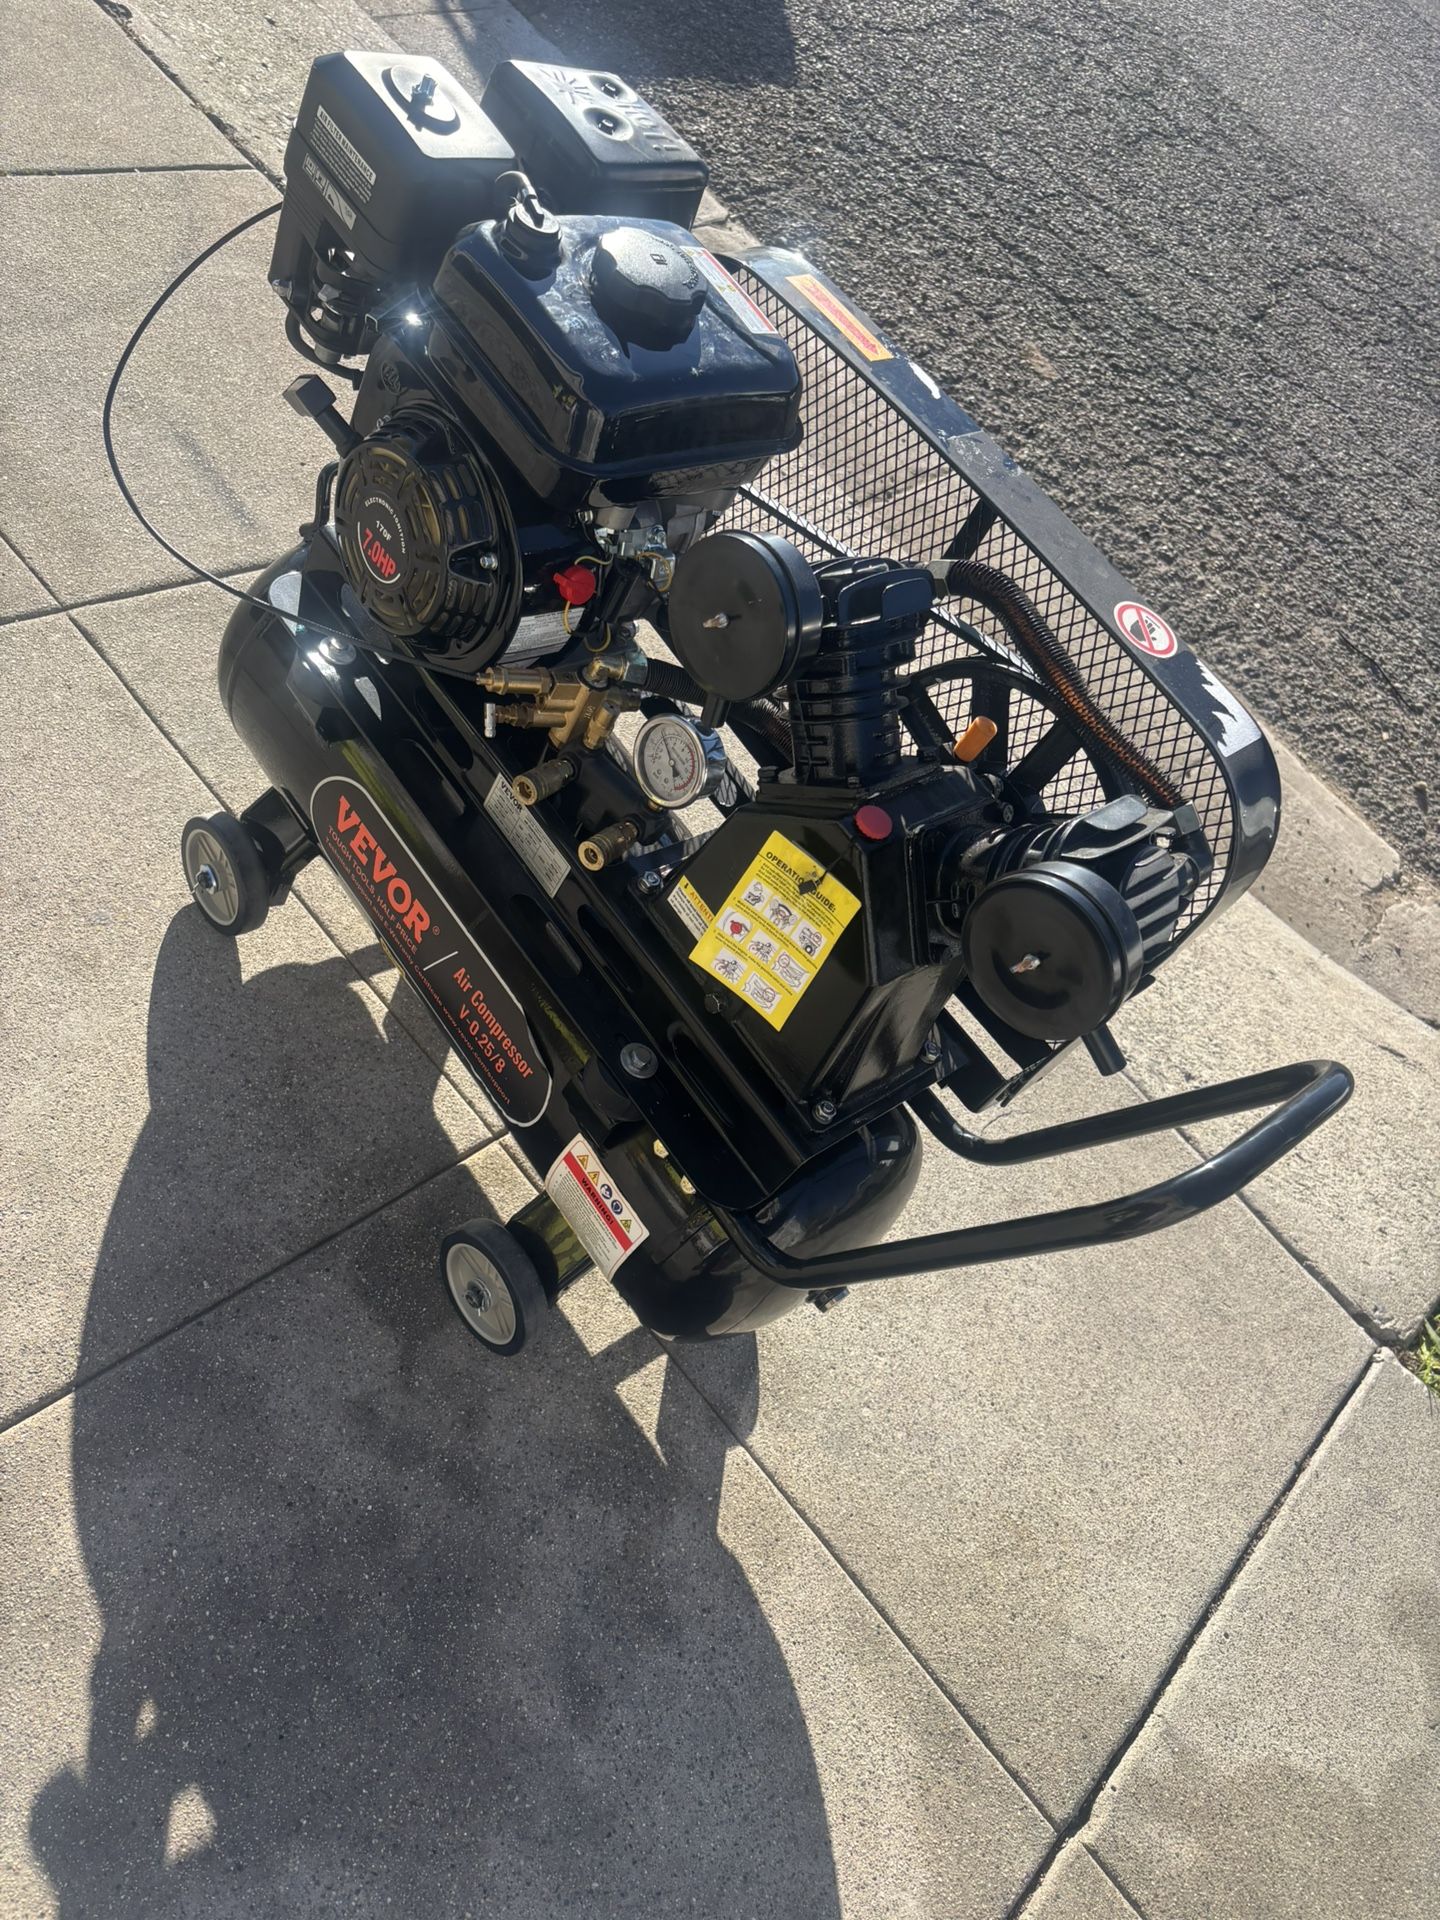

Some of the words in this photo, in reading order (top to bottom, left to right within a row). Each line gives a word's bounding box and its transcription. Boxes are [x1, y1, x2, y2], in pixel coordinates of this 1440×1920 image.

[327, 120, 343, 143] FILTER
[341, 137, 374, 181] MAINTENANCE
[362, 527, 397, 578] 7.0HP
[364, 496, 394, 516] ELECTRONIC
[392, 513, 406, 555] IGNITION
[375, 520, 393, 541] 170F
[500, 780, 524, 814] VEVOR
[327, 825, 353, 862] TOUGH
[351, 858, 376, 899] TOOLS,
[376, 895, 397, 923] HALF
[395, 921, 418, 956] PRICE
[335, 794, 431, 944] VEVOR
[765, 850, 806, 886] OPERATIO
[810, 888, 837, 913] GUIDE:
[325, 836, 352, 875] Technical
[351, 872, 373, 907] Support
[372, 904, 385, 923] and
[413, 964, 444, 1008] Certificate
[452, 967, 473, 993] Air
[469, 989, 534, 1080] Compressor
[458, 1003, 507, 1074] V-0.25/8
[580, 1177, 615, 1226] WARNING!
